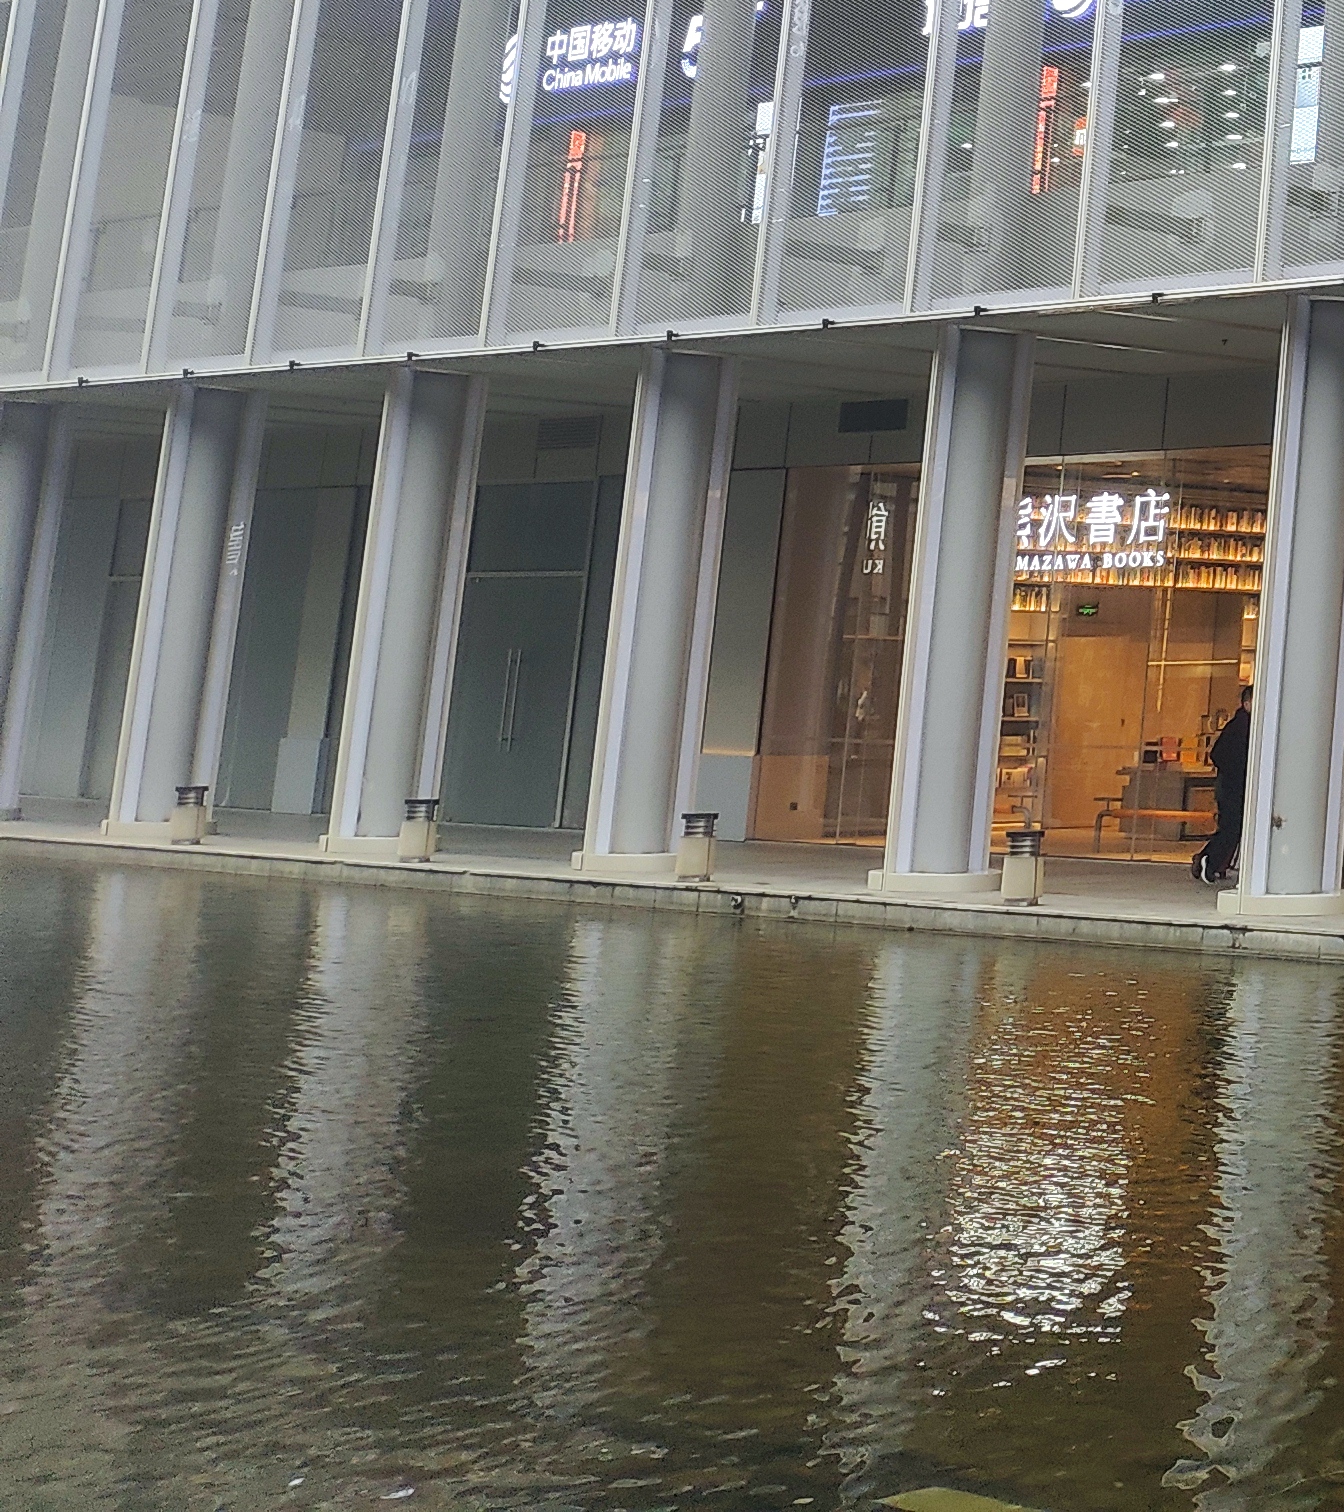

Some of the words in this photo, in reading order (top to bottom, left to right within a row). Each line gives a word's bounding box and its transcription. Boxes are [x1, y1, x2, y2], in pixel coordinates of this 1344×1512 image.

[546, 17, 637, 64] 中国移动
[543, 65, 583, 91] China
[583, 57, 632, 85] Mobile
[1015, 553, 1093, 571] MAZAWA
[1102, 551, 1165, 569] BOOKS
